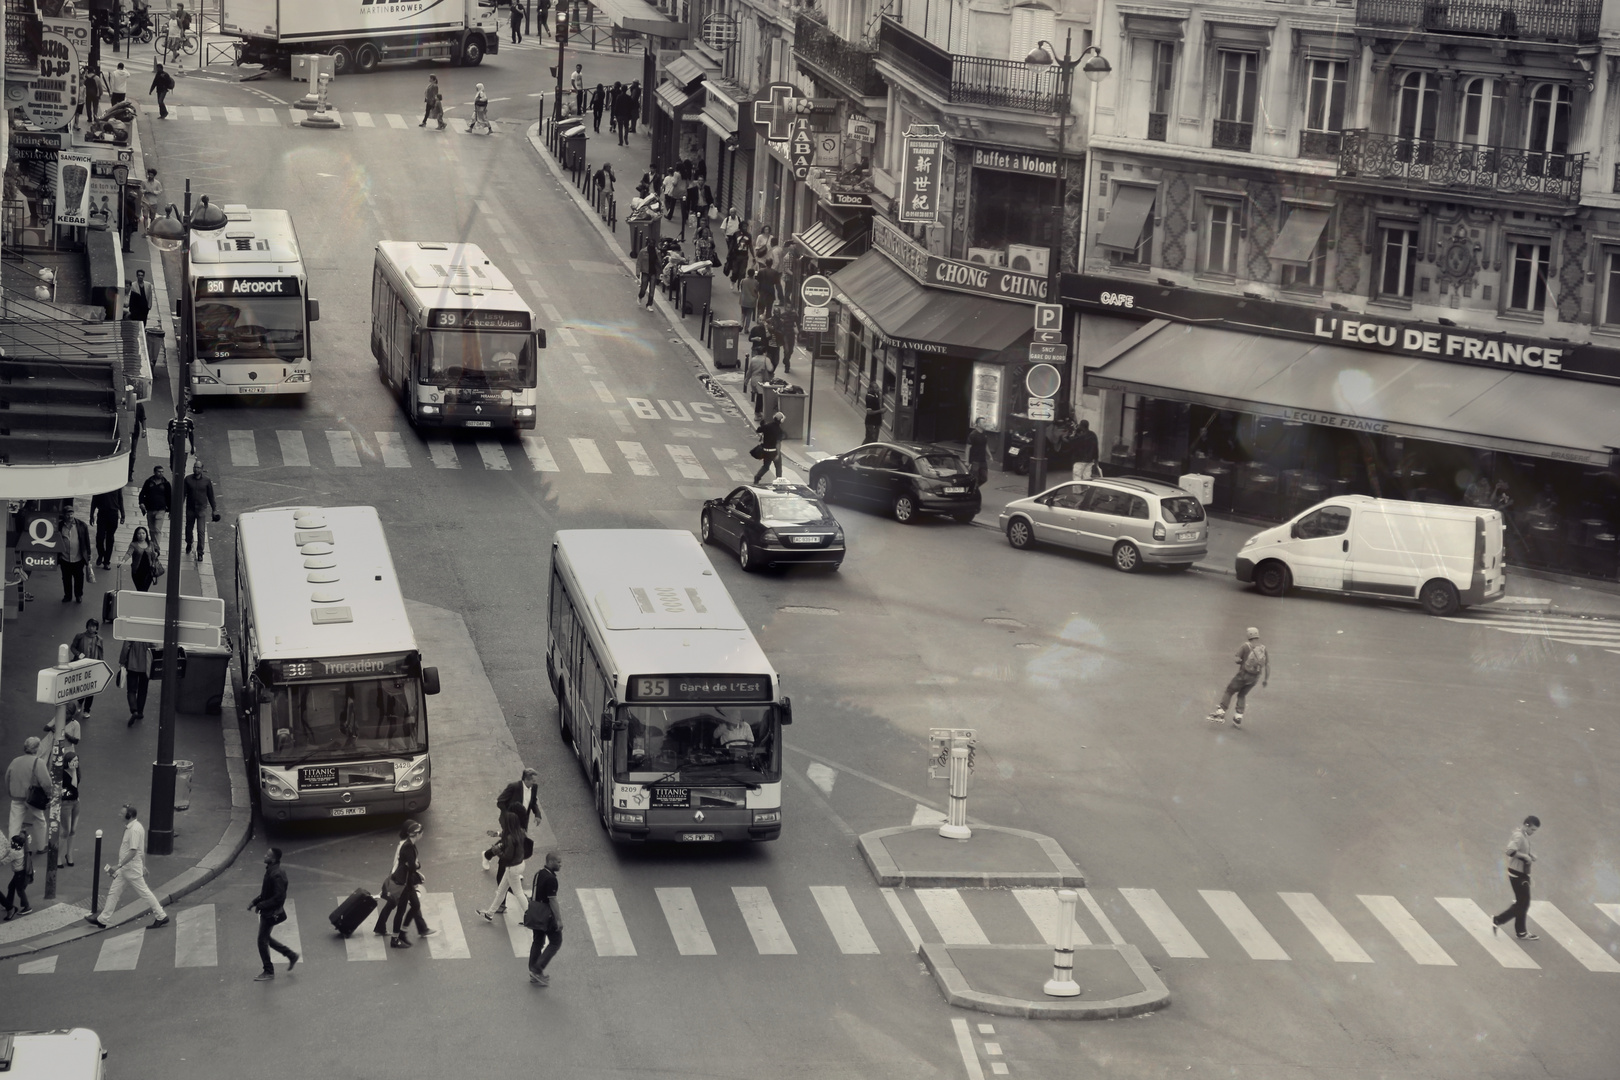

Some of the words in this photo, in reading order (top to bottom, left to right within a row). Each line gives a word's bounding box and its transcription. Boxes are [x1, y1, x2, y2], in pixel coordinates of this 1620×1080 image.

[360, 4, 423, 14] MARTINBROWER
[16, 150, 58, 160] RESTAURAN
[793, 118, 812, 178] TABAC
[60, 154, 91, 163] SANDWICH
[976, 150, 1010, 168] Buffet
[1013, 154, 1020, 169] à
[911, 155, 932, 210] 新世紀
[836, 194, 863, 204] Tabac
[58, 215, 86, 224] KEBAB
[206, 279, 225, 292] 350
[231, 278, 283, 296] Aéroport
[935, 262, 989, 289] CHONG
[1000, 274, 1048, 299] CHING
[1100, 291, 1134, 309] CAFE
[439, 313, 456, 325] 39
[484, 313, 504, 322] Issy
[498, 319, 523, 328] Voisin
[1042, 309, 1055, 326] P
[909, 342, 947, 354] VOLONTE
[1403, 329, 1442, 354] DE
[1445, 333, 1564, 372] FRANCE
[627, 397, 726, 424] BUS
[1320, 415, 1337, 426] DE
[1340, 418, 1389, 432] FRANCE
[1550, 451, 1591, 463] BRASSERIE
[28, 518, 57, 549] Q
[25, 556, 55, 567] Quick
[288, 663, 306, 676] 30
[323, 659, 384, 675] Trocadéro
[64, 673, 82, 685] PORTE
[84, 670, 92, 680] DE
[57, 681, 97, 699] CLIGNANCOURT
[643, 681, 665, 697] 35
[680, 682, 709, 693] Gare
[712, 682, 728, 693] de
[303, 768, 336, 776] TITANIC
[662, 773, 676, 782] 35
[655, 788, 688, 796] TITANIC
